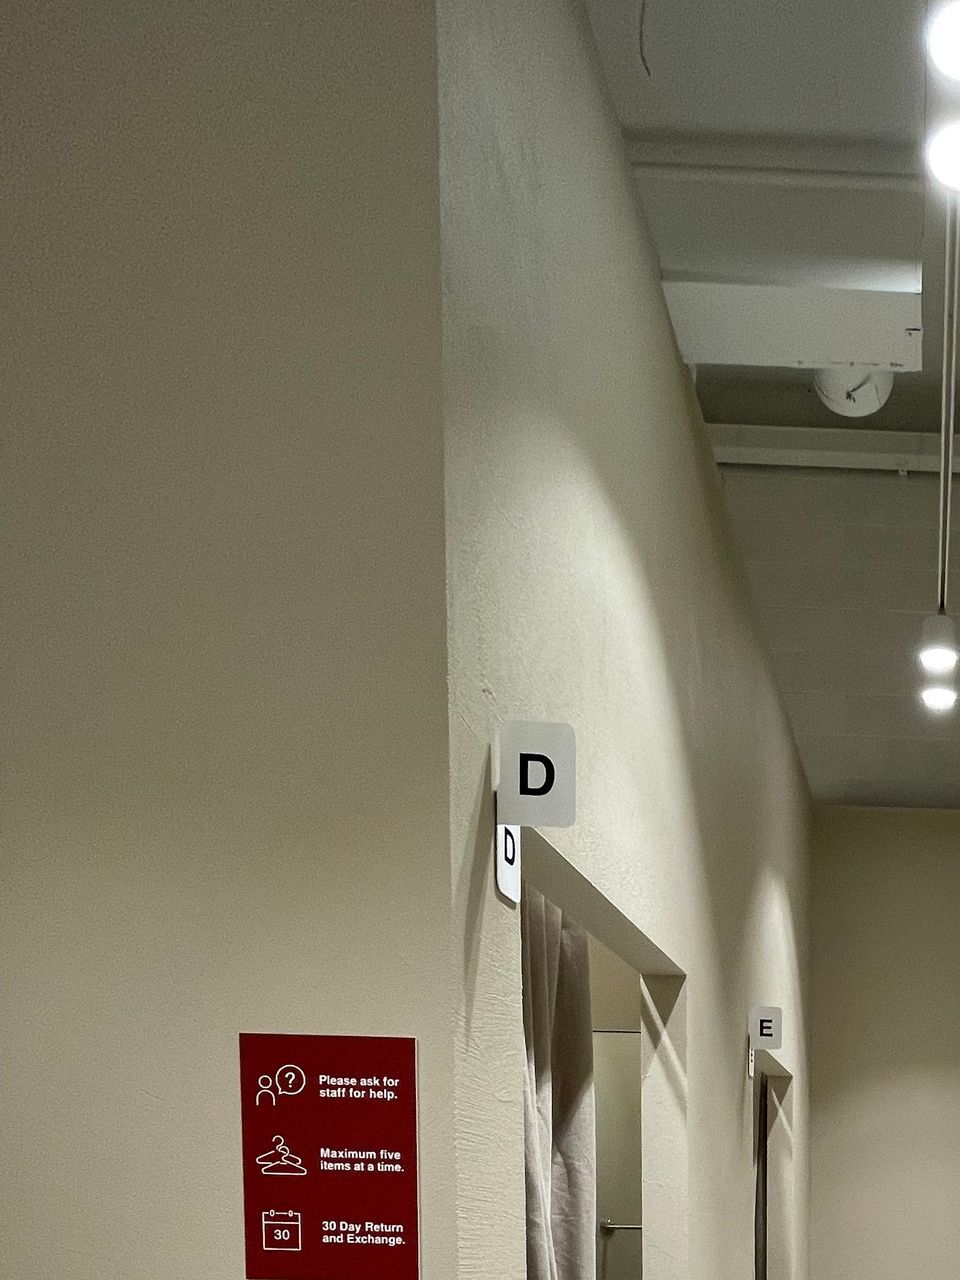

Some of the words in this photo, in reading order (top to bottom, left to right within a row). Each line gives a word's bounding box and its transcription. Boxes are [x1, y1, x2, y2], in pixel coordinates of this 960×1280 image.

[519, 752, 556, 796] D
[504, 826, 516, 866] D
[759, 1018, 773, 1037] E
[319, 1074, 357, 1086] Please
[360, 1076, 380, 1087] ask
[382, 1076, 400, 1087] for
[319, 1088, 346, 1098] staff
[348, 1088, 366, 1098] for
[369, 1089, 398, 1101] help.
[320, 1147, 377, 1159] Maximum
[379, 1149, 401, 1160] five
[320, 1160, 351, 1171] items
[353, 1162, 365, 1171] at
[367, 1163, 375, 1172] a
[377, 1161, 405, 1172] time.
[321, 1221, 337, 1231] 30
[339, 1221, 362, 1233] Day
[365, 1222, 404, 1233] Return
[273, 1229, 290, 1241] 30
[322, 1234, 344, 1243] and
[346, 1234, 406, 1247] Exchange.
